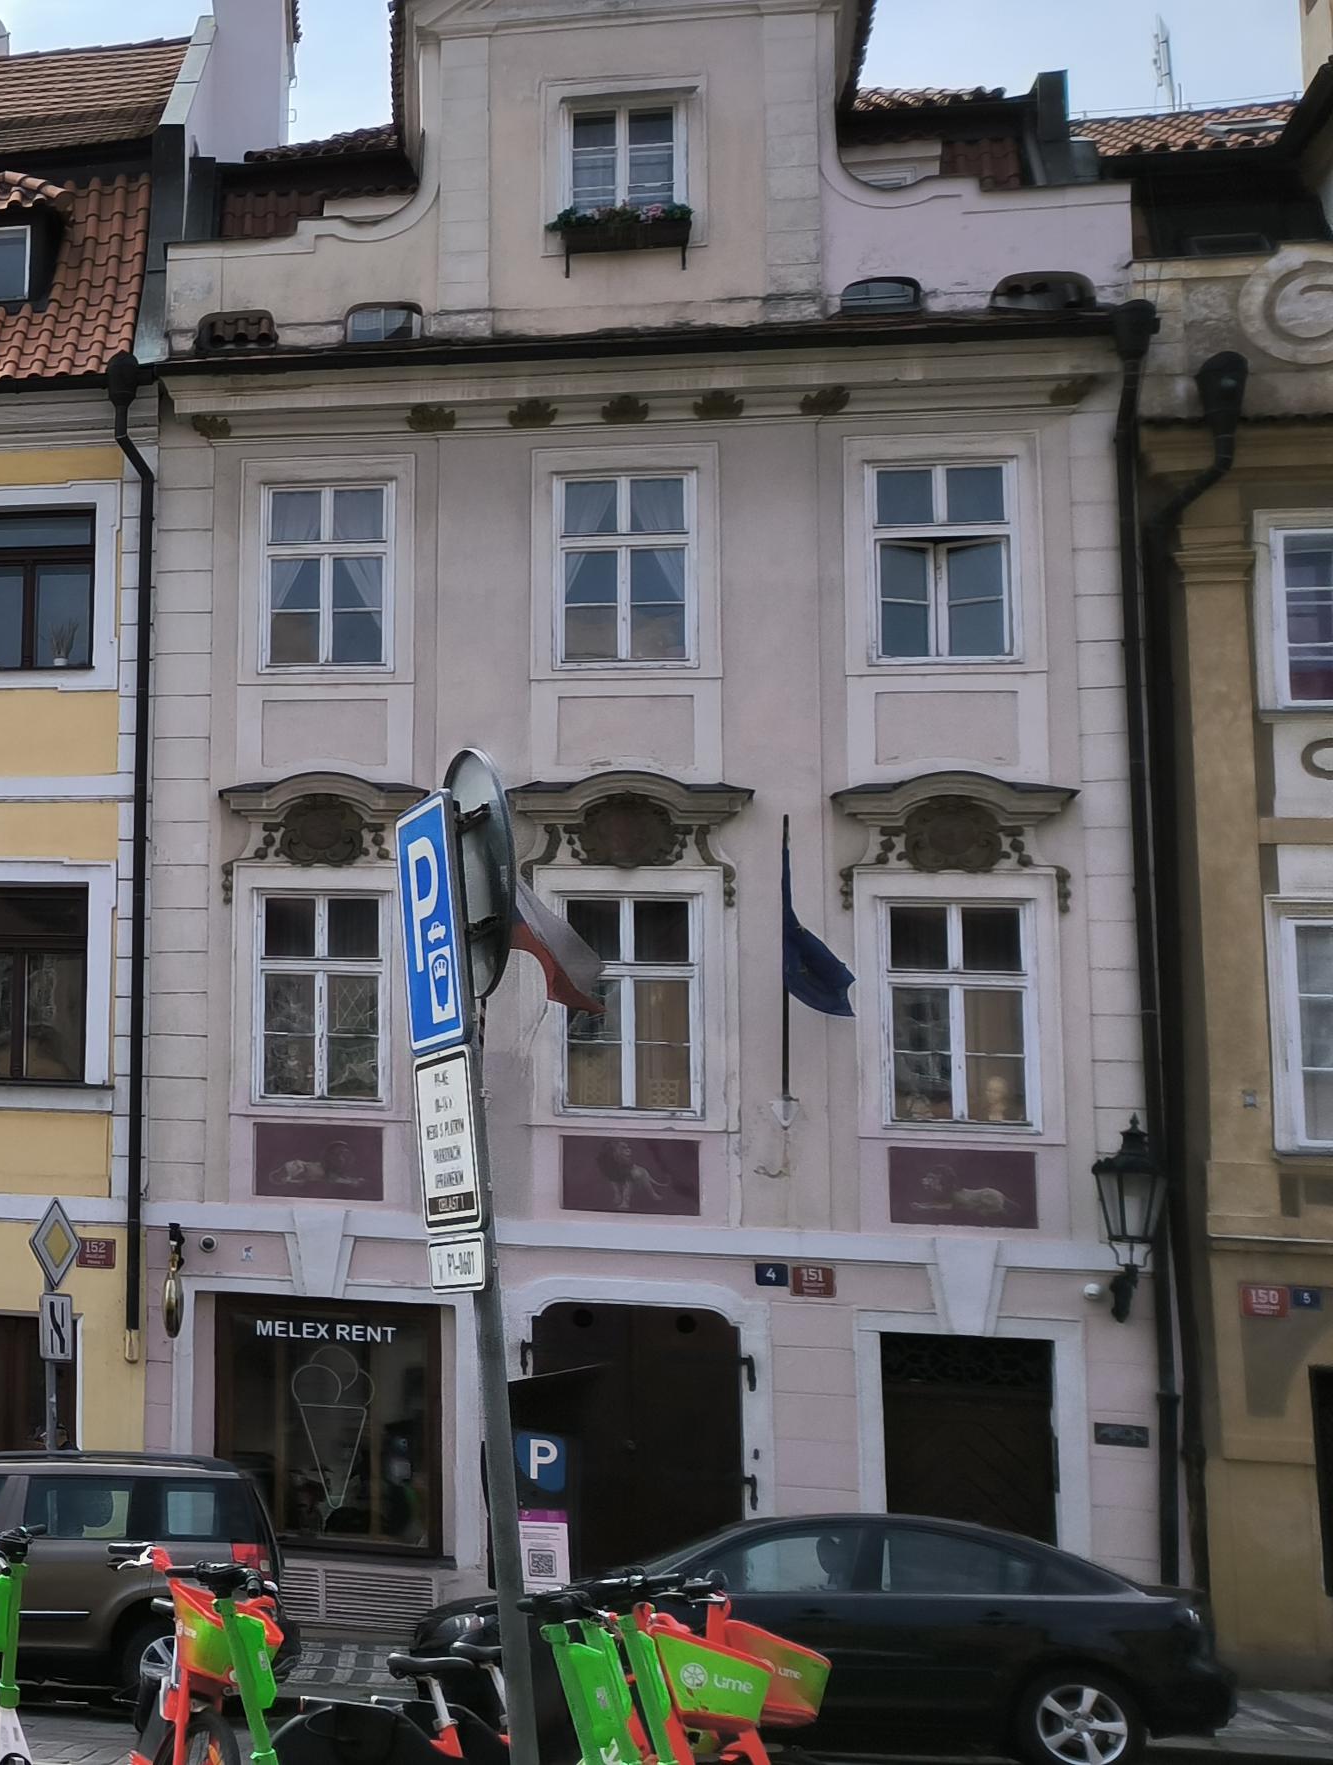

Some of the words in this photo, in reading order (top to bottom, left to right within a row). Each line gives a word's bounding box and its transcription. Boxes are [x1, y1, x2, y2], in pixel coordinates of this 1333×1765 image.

[407, 836, 439, 973] P
[85, 1241, 106, 1253] 152
[765, 1267, 777, 1281] 4
[801, 1268, 823, 1282] 151
[1250, 1288, 1279, 1304] 150
[256, 1320, 330, 1340] MELEX
[335, 1324, 397, 1344] RENT
[529, 1438, 558, 1480] P
[713, 1675, 754, 1695] Lime
